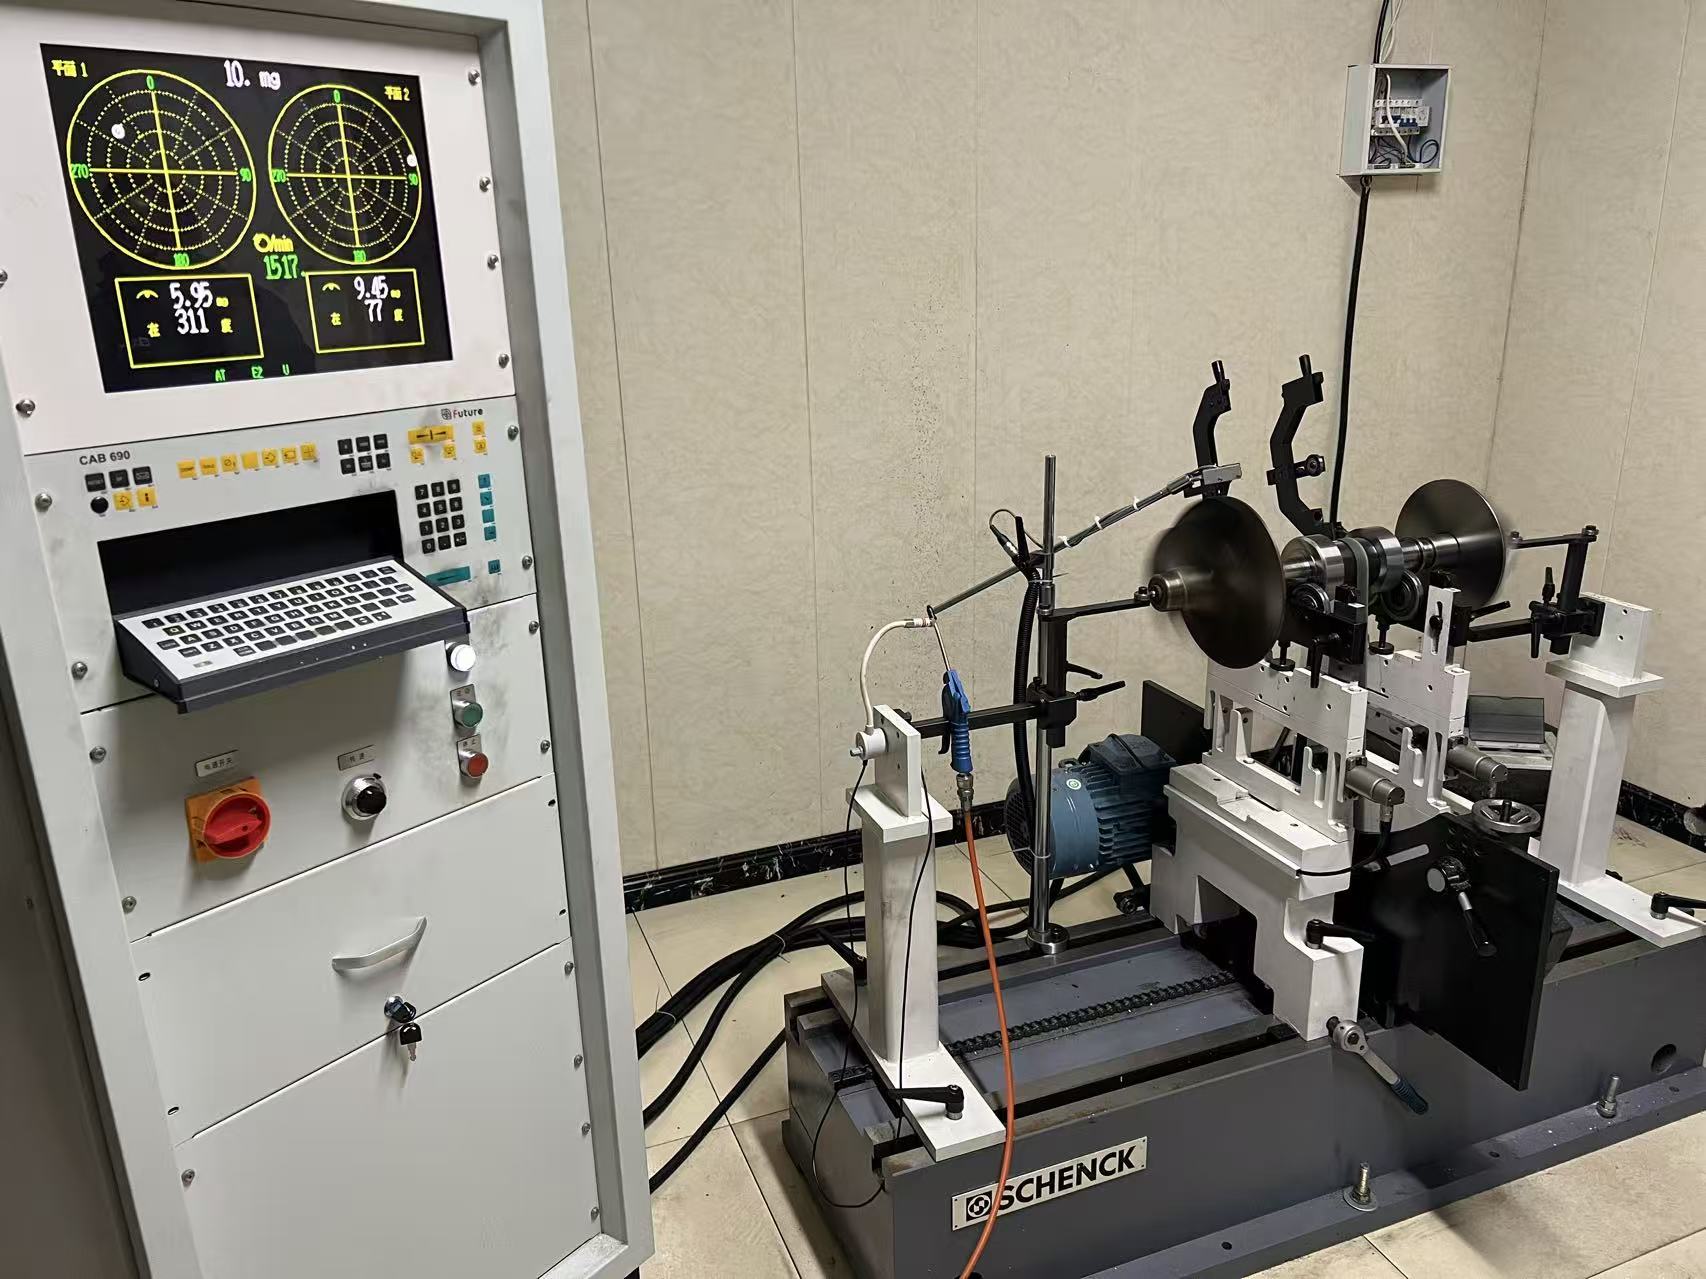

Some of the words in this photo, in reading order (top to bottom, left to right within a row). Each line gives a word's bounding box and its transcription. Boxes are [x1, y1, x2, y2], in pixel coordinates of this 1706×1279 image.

[146, 75, 155, 90] 0
[259, 71, 281, 90] mg
[333, 89, 341, 103] 0
[71, 164, 90, 179] 270
[240, 168, 252, 182] 90
[169, 281, 213, 309] 5.95
[353, 275, 388, 300] 9.45
[364, 299, 382, 322] 77
[174, 307, 210, 335] 311
[282, 364, 290, 376] U
[452, 408, 484, 419] Future
[79, 453, 107, 465] CAB
[109, 450, 131, 462] 690
[1000, 1145, 1137, 1210] SCHENCK
